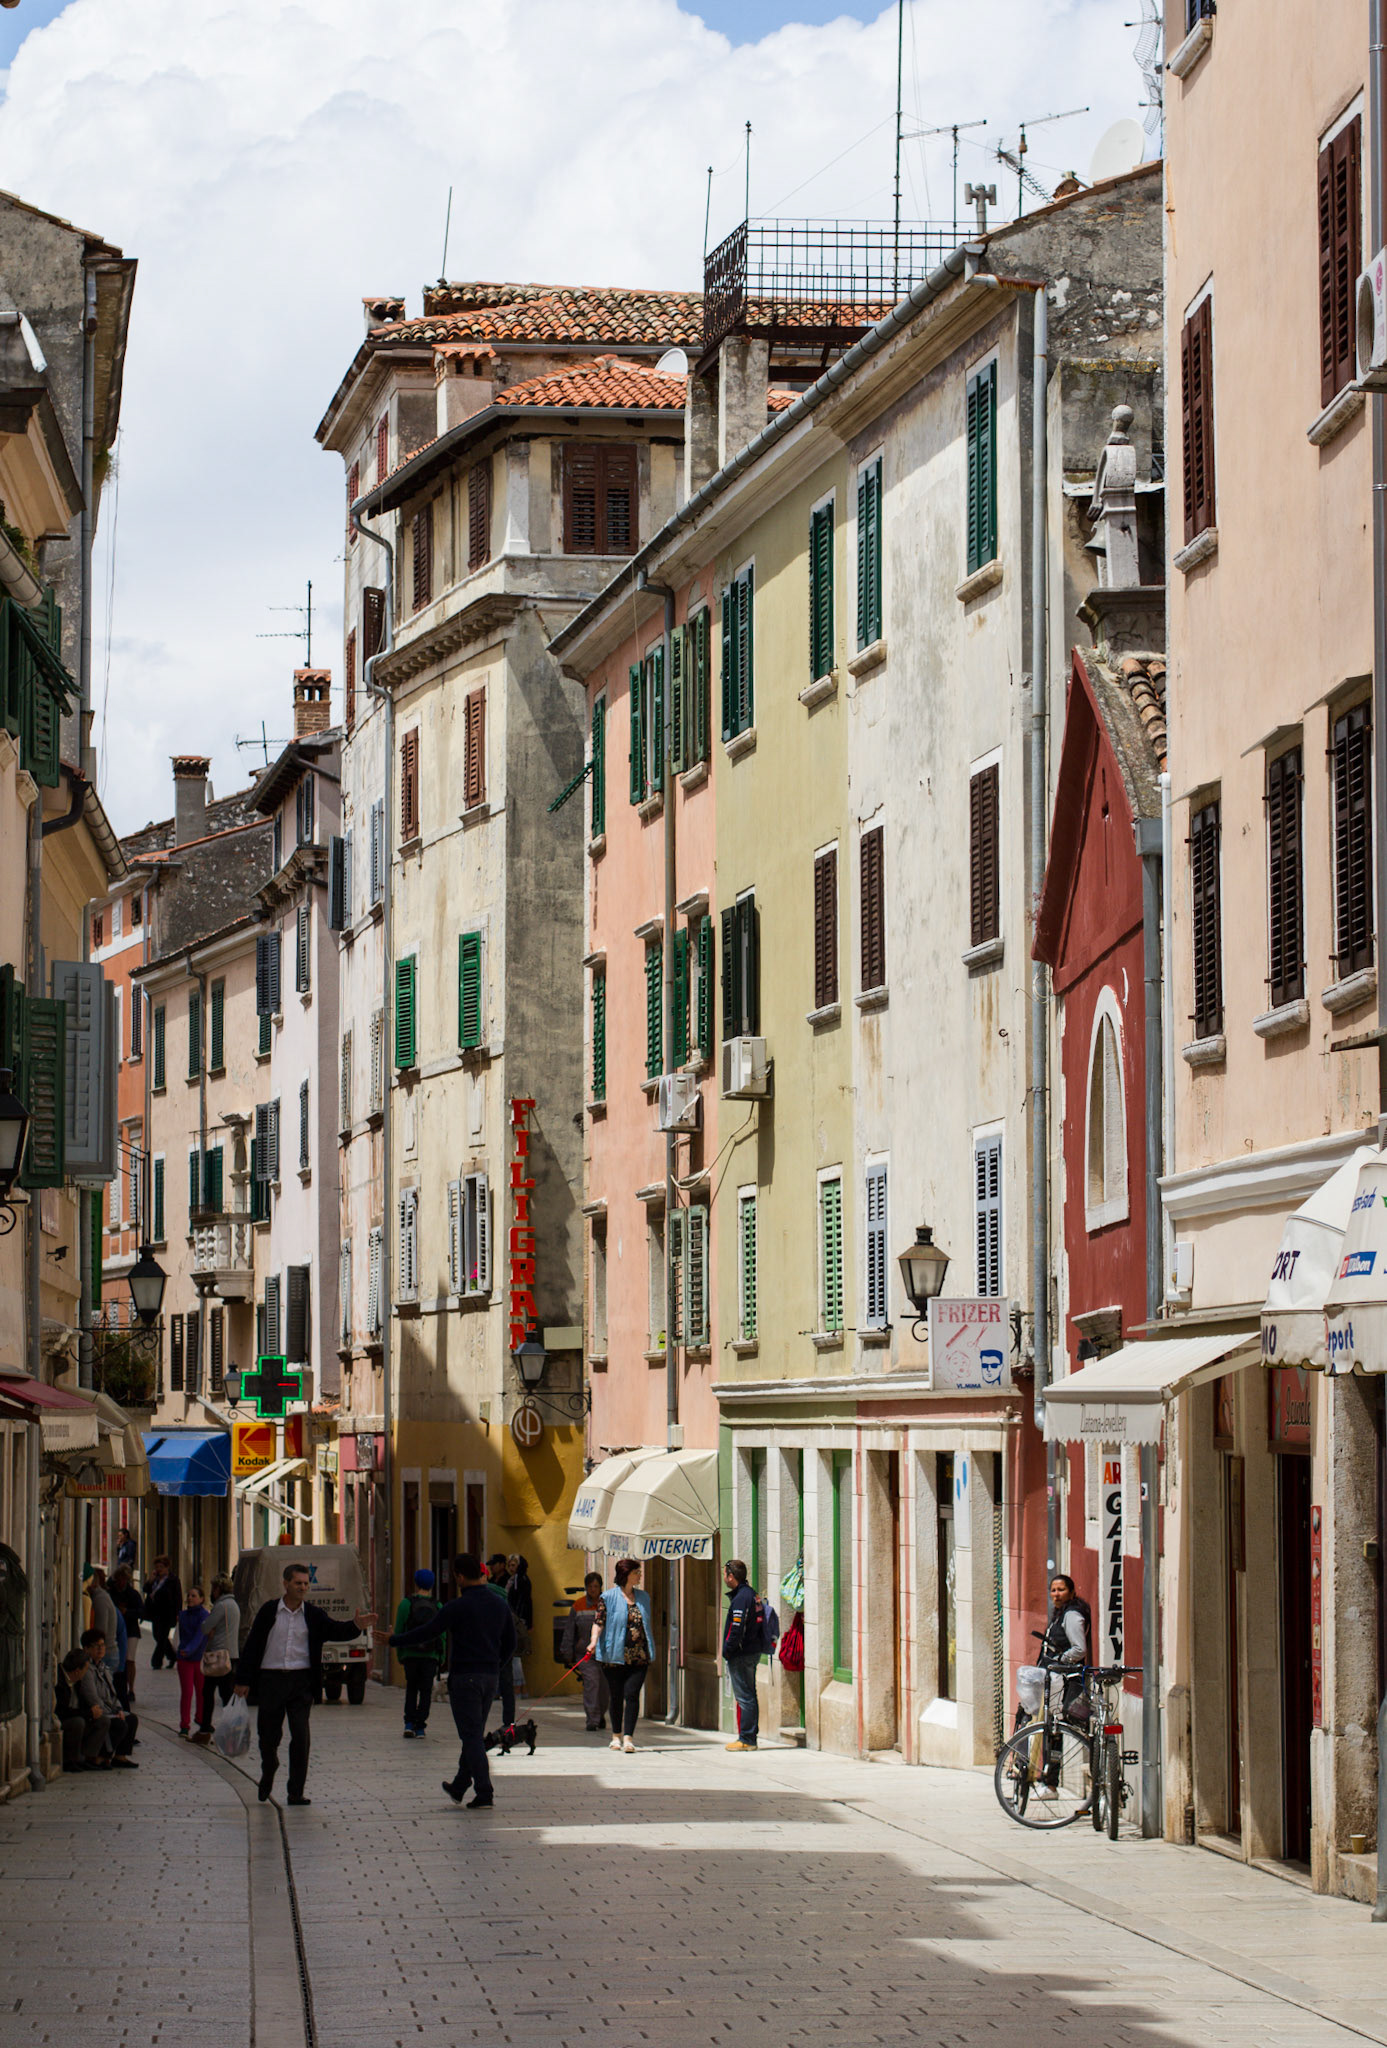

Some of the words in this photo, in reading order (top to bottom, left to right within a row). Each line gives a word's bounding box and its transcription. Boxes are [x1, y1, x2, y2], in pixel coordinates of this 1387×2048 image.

[509, 1099, 539, 1349] FILIGRAN
[938, 1303, 1001, 1323] FRIZER
[238, 1456, 271, 1466] Kodak
[643, 1538, 709, 1555] INTERNET
[1106, 1491, 1123, 1662] GALLERY
